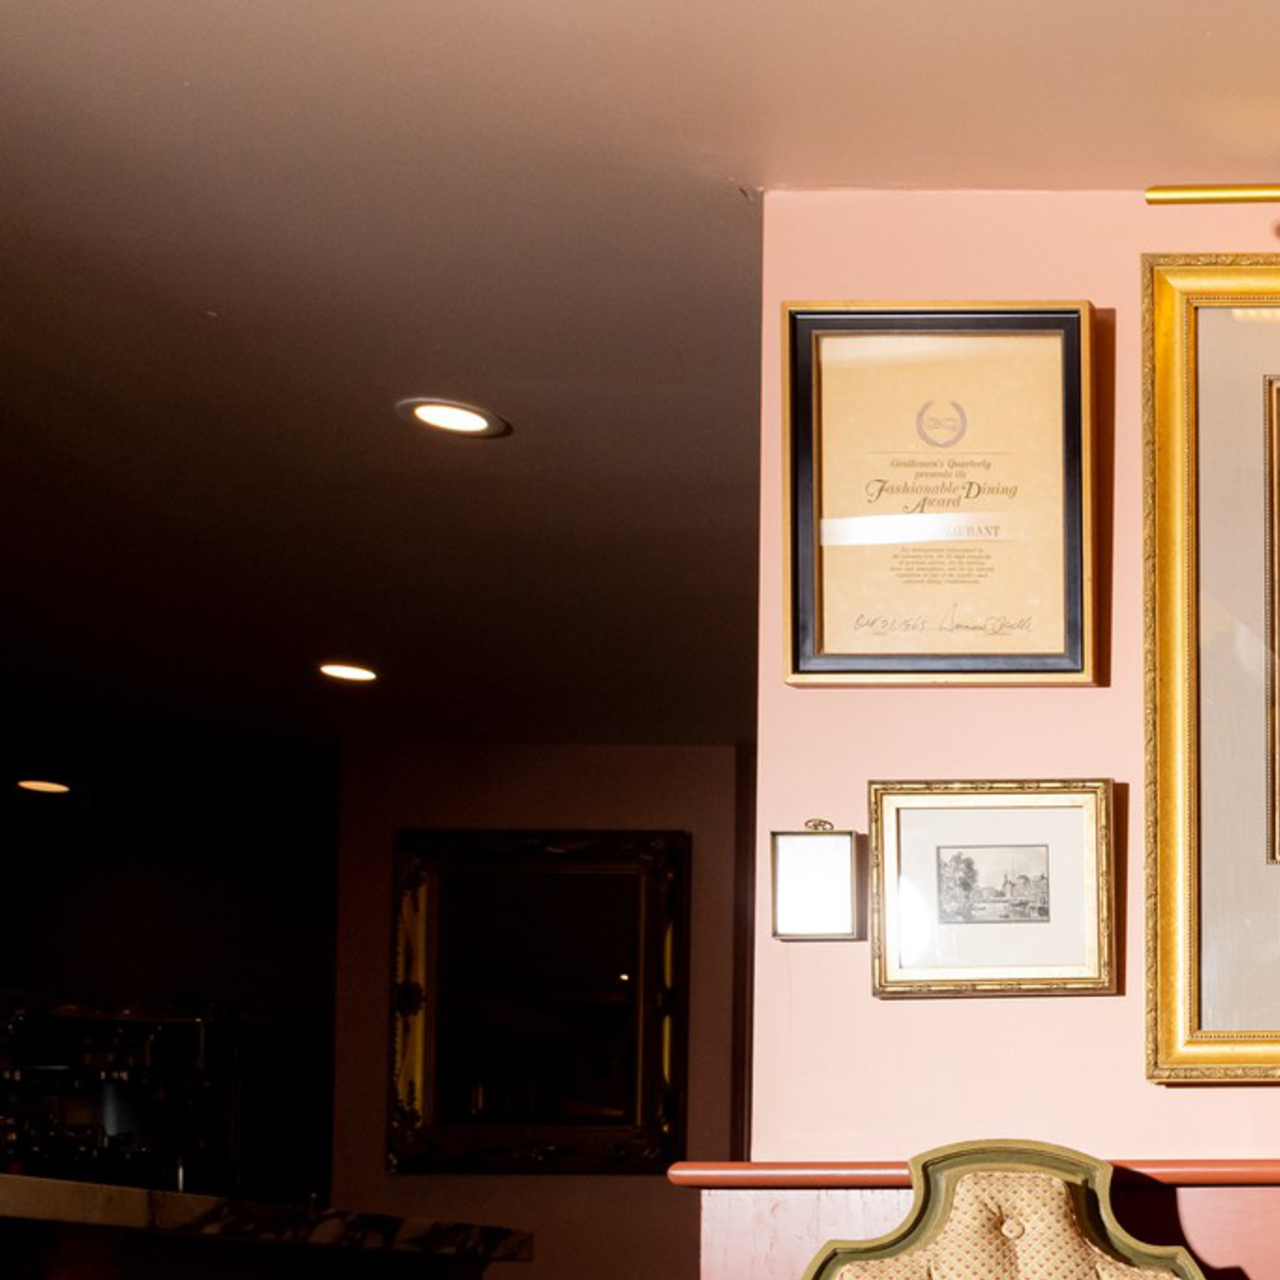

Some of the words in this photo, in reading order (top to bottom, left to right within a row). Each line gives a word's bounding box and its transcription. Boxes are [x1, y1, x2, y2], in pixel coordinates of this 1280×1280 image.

[947, 459, 992, 470] Quarterly
[865, 478, 959, 503] Fashionable
[961, 480, 1018, 499] Dining
[903, 495, 962, 514] Award
